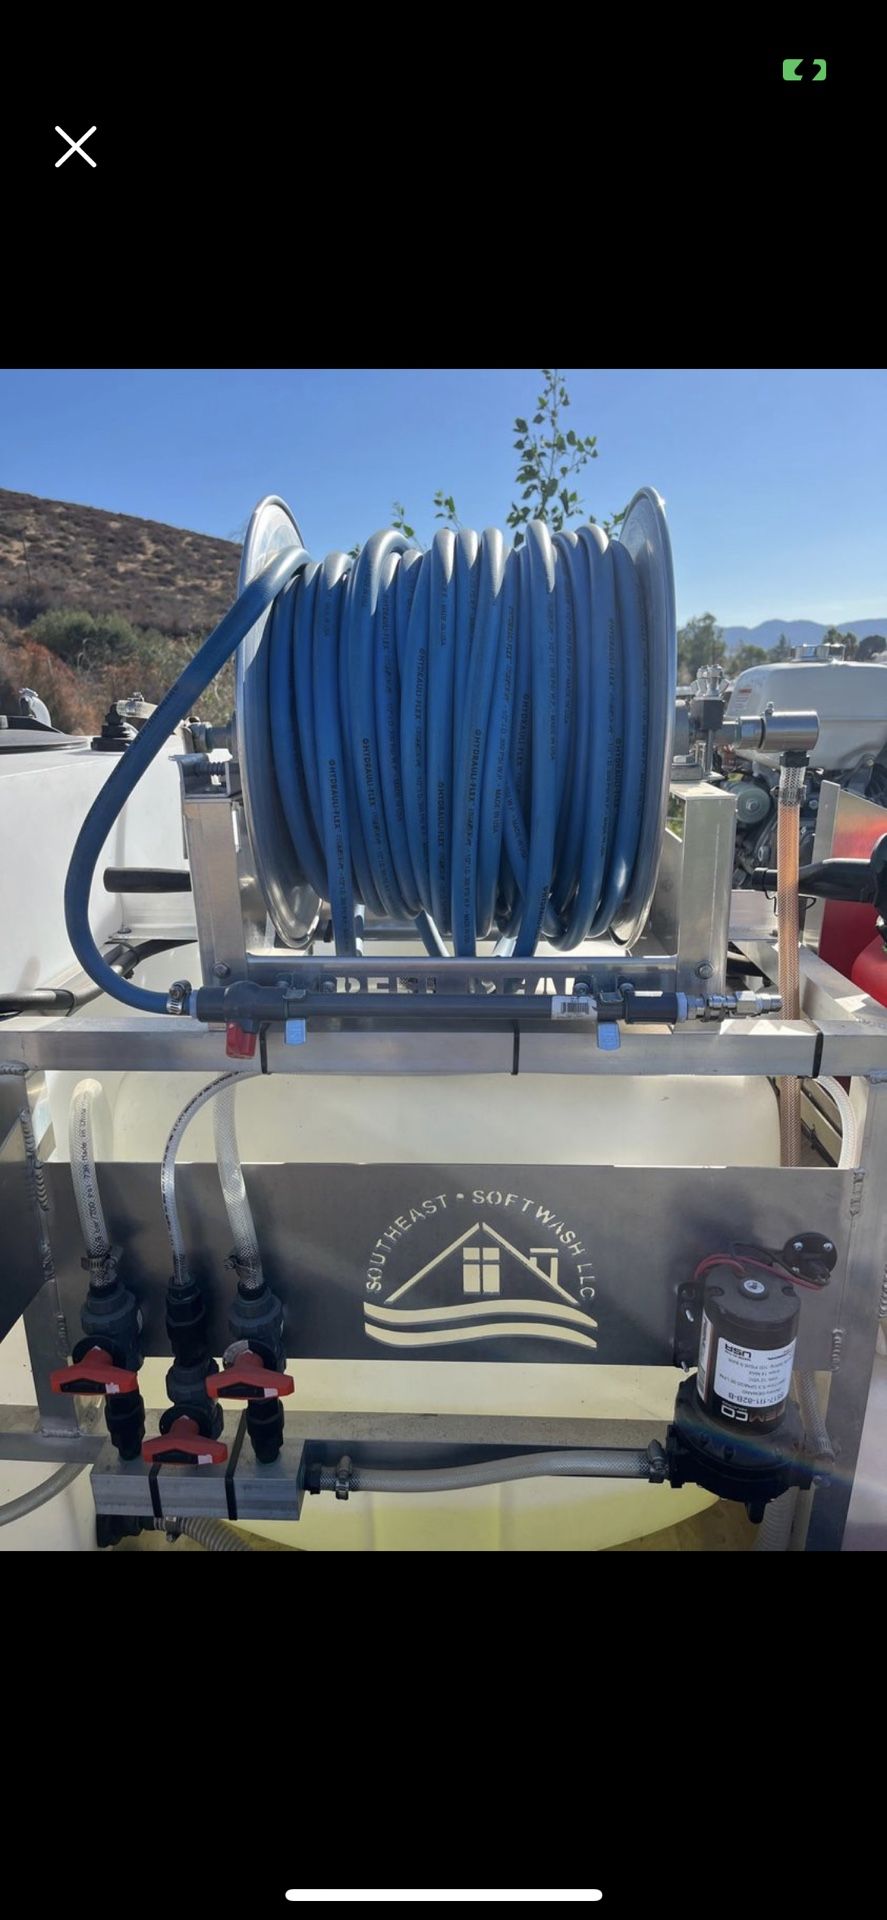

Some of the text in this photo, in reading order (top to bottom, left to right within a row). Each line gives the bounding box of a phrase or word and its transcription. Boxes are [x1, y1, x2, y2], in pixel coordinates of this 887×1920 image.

[366, 1194, 447, 1293] SOUTHEAST
[576, 1263, 596, 1298] LLC
[724, 1344, 752, 1359] USA
